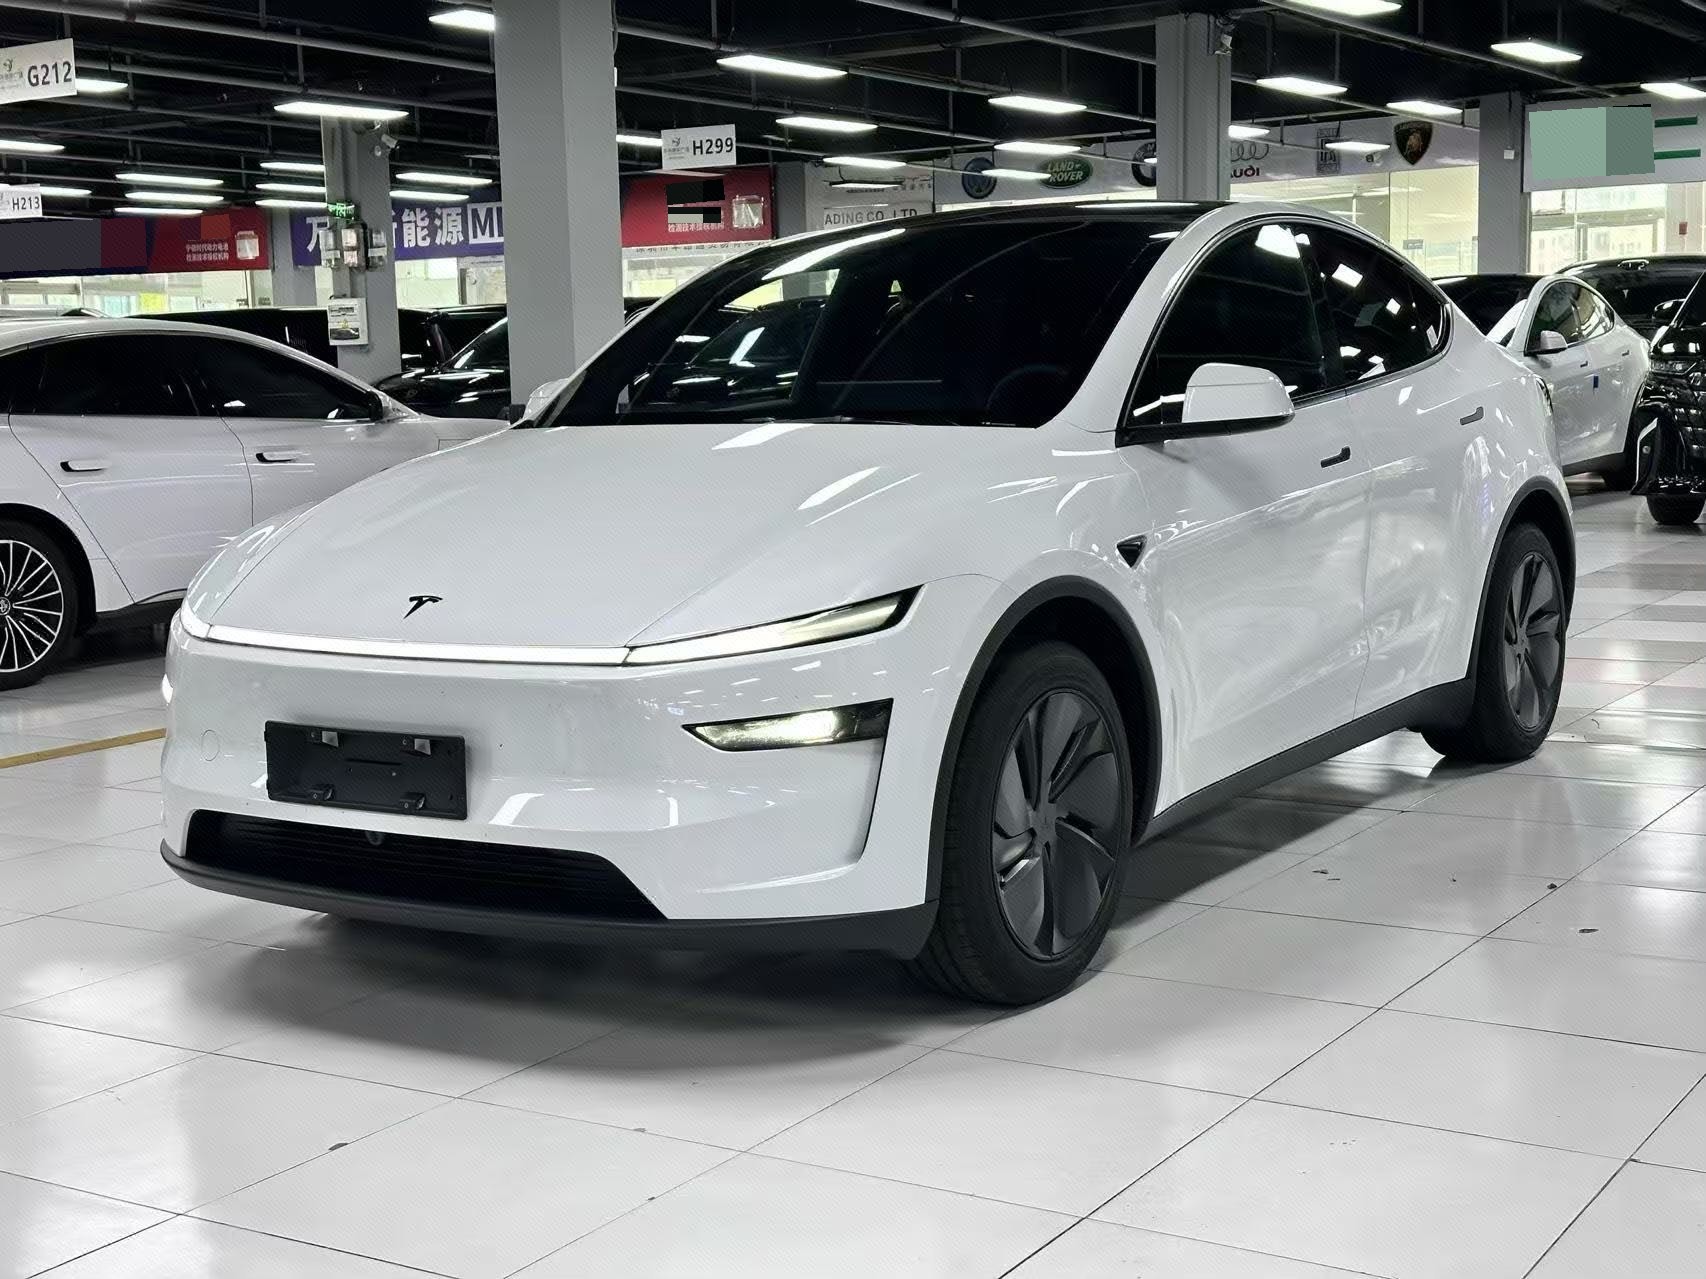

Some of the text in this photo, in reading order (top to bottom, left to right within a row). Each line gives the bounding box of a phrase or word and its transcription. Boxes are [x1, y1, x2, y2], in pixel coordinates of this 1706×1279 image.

[27, 60, 73, 87] G212
[692, 137, 734, 156] H299
[1047, 160, 1075, 172] LAND
[1049, 170, 1084, 182] ROVER
[12, 196, 40, 210] H213
